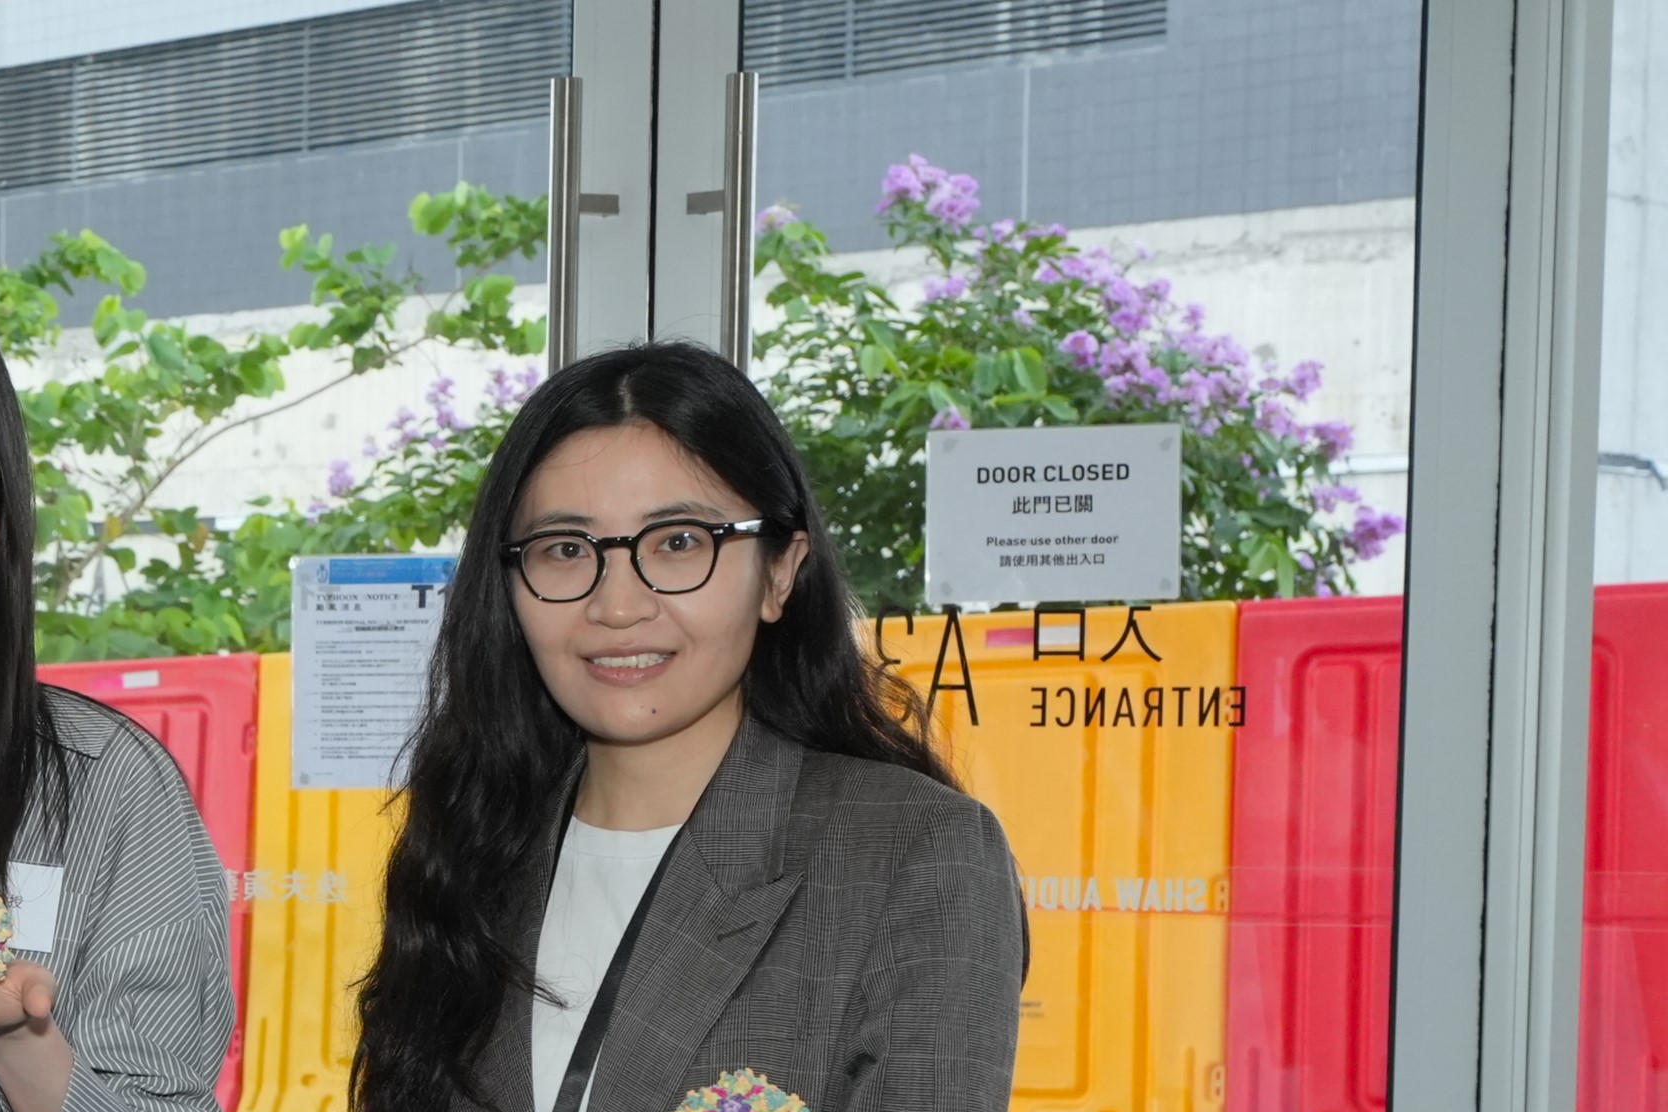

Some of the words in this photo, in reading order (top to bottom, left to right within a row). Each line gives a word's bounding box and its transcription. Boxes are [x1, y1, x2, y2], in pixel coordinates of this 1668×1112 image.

[977, 465, 1035, 484] DOOR
[1043, 463, 1129, 482] CLOSED
[1011, 494, 1093, 514] 此門已關
[986, 536, 1026, 546] Please
[1029, 537, 1051, 545] use
[1054, 534, 1087, 545] other
[1090, 534, 1118, 544] door
[998, 553, 1105, 567] 請使用其他出入口
[316, 593, 358, 601] TYPHOON
[367, 593, 398, 601] NOTICE
